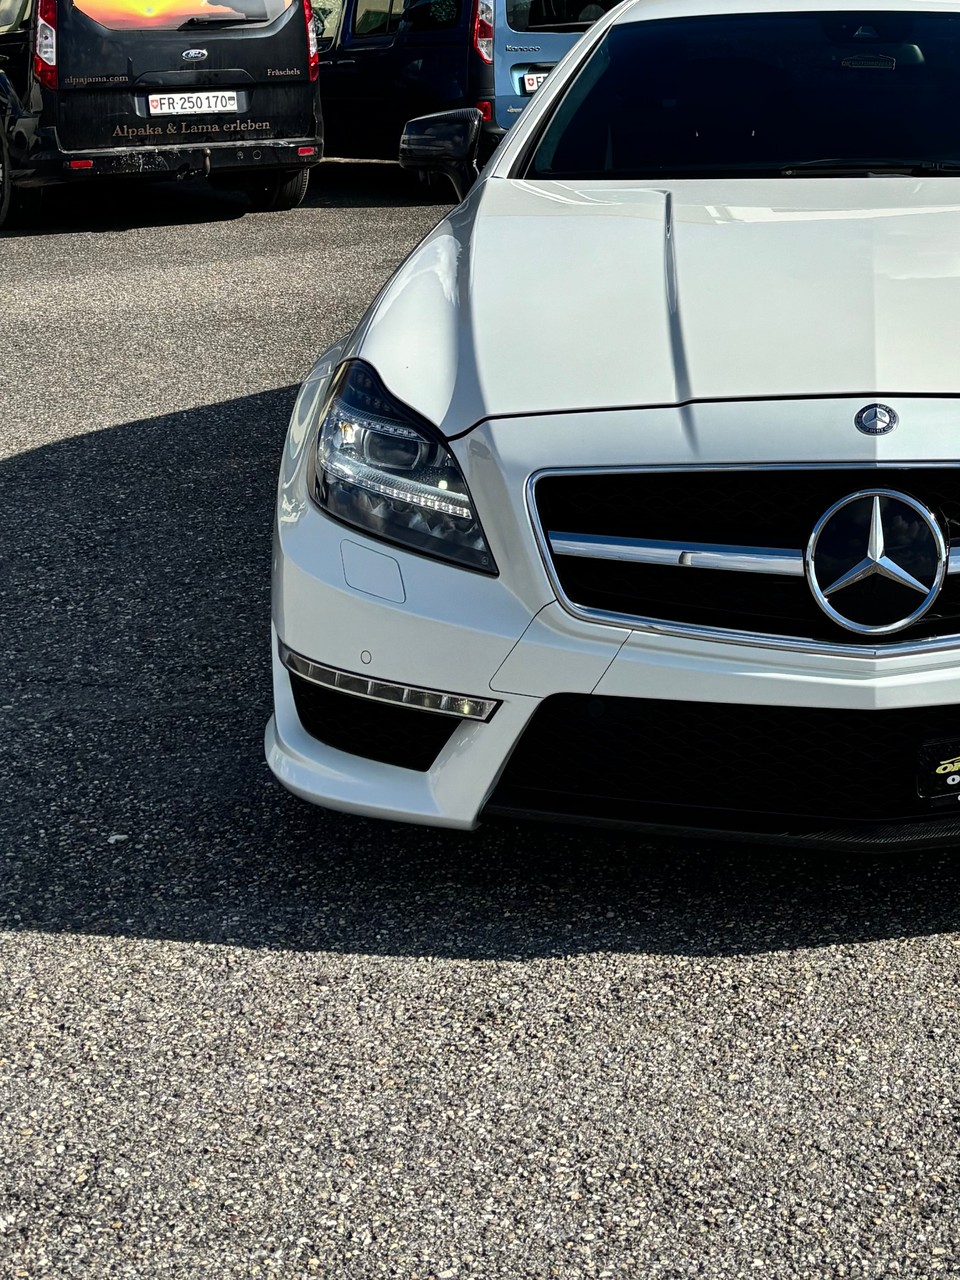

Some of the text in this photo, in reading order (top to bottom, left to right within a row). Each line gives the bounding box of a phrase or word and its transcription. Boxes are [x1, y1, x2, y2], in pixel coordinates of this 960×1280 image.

[112, 120, 270, 138] Alpaka & Lama erleben
